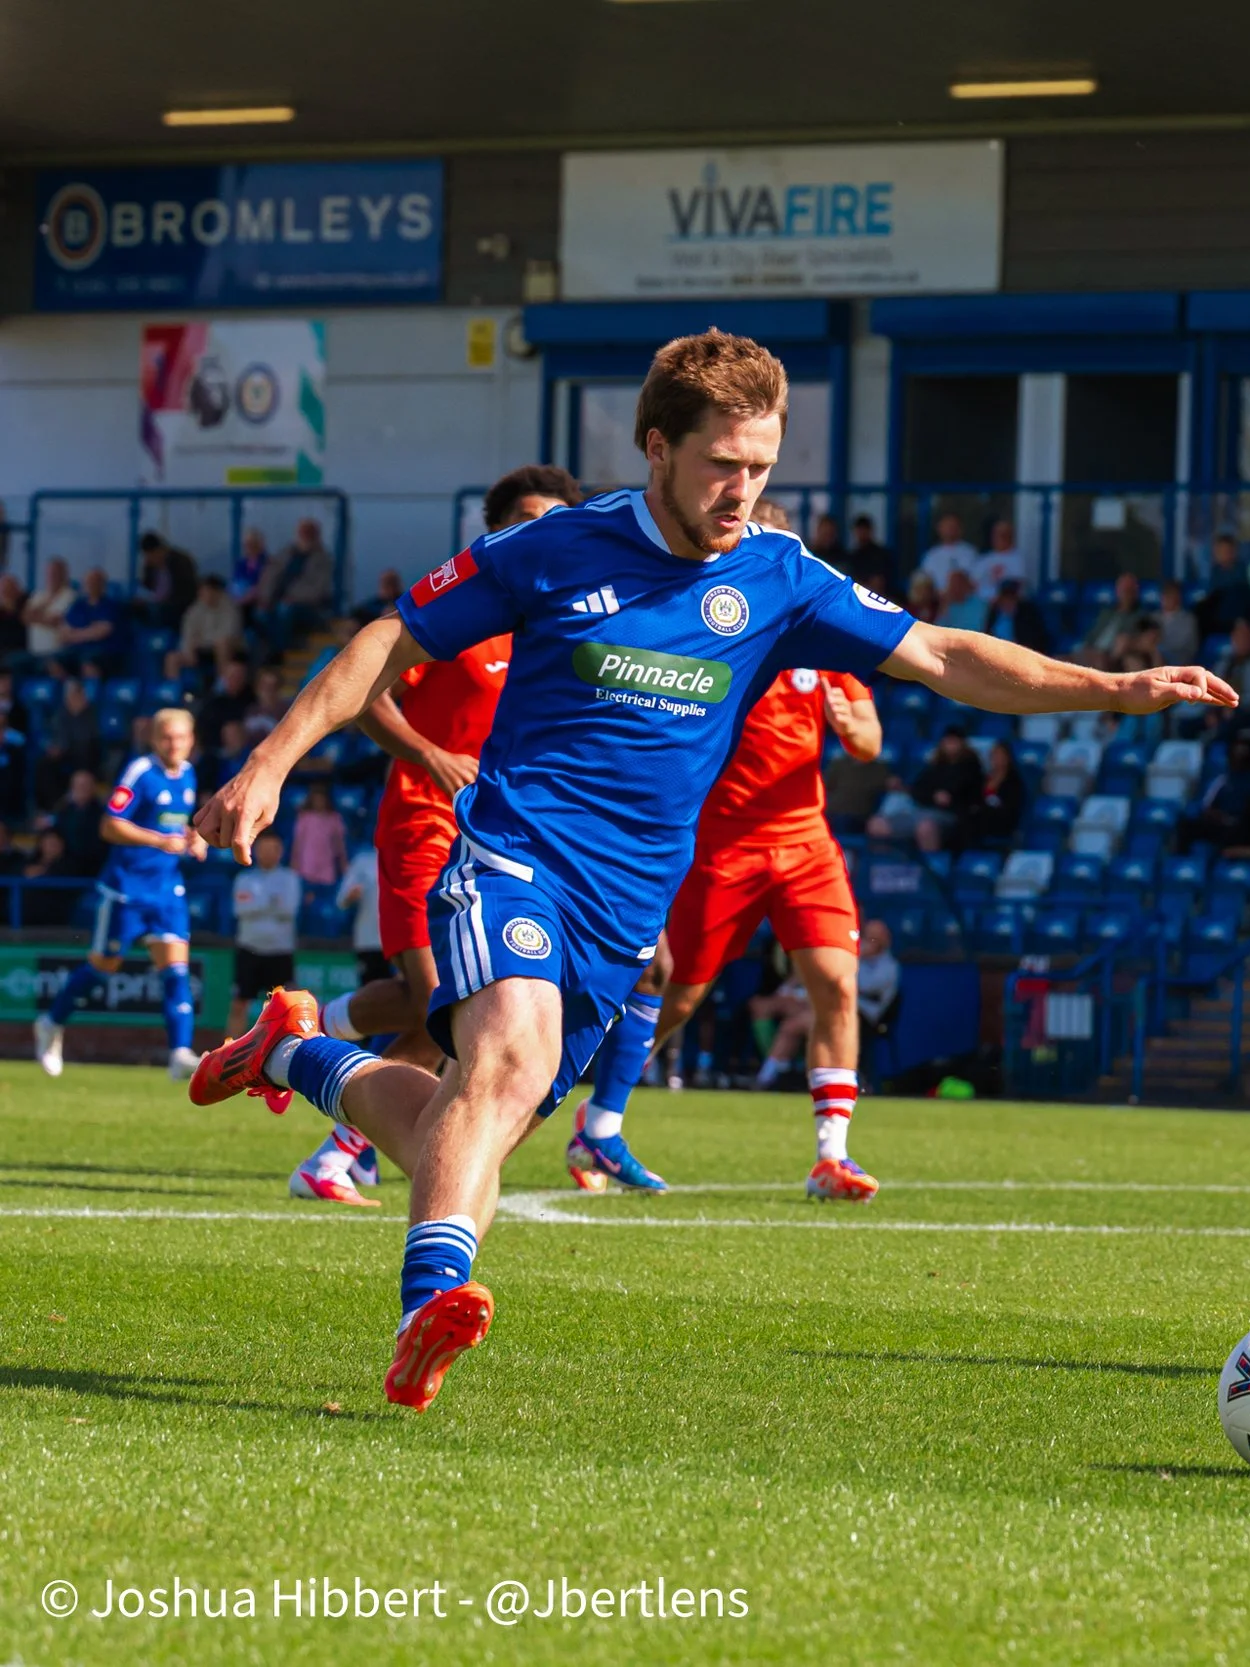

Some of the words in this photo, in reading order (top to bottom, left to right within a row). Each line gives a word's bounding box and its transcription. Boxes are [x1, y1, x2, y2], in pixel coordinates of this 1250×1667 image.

[112, 193, 433, 248] BROMLEYS
[706, 614, 732, 632] FOOTBALL
[598, 654, 714, 694] Pinnacle
[595, 688, 656, 709] Electrical
[658, 697, 706, 717] Supplies
